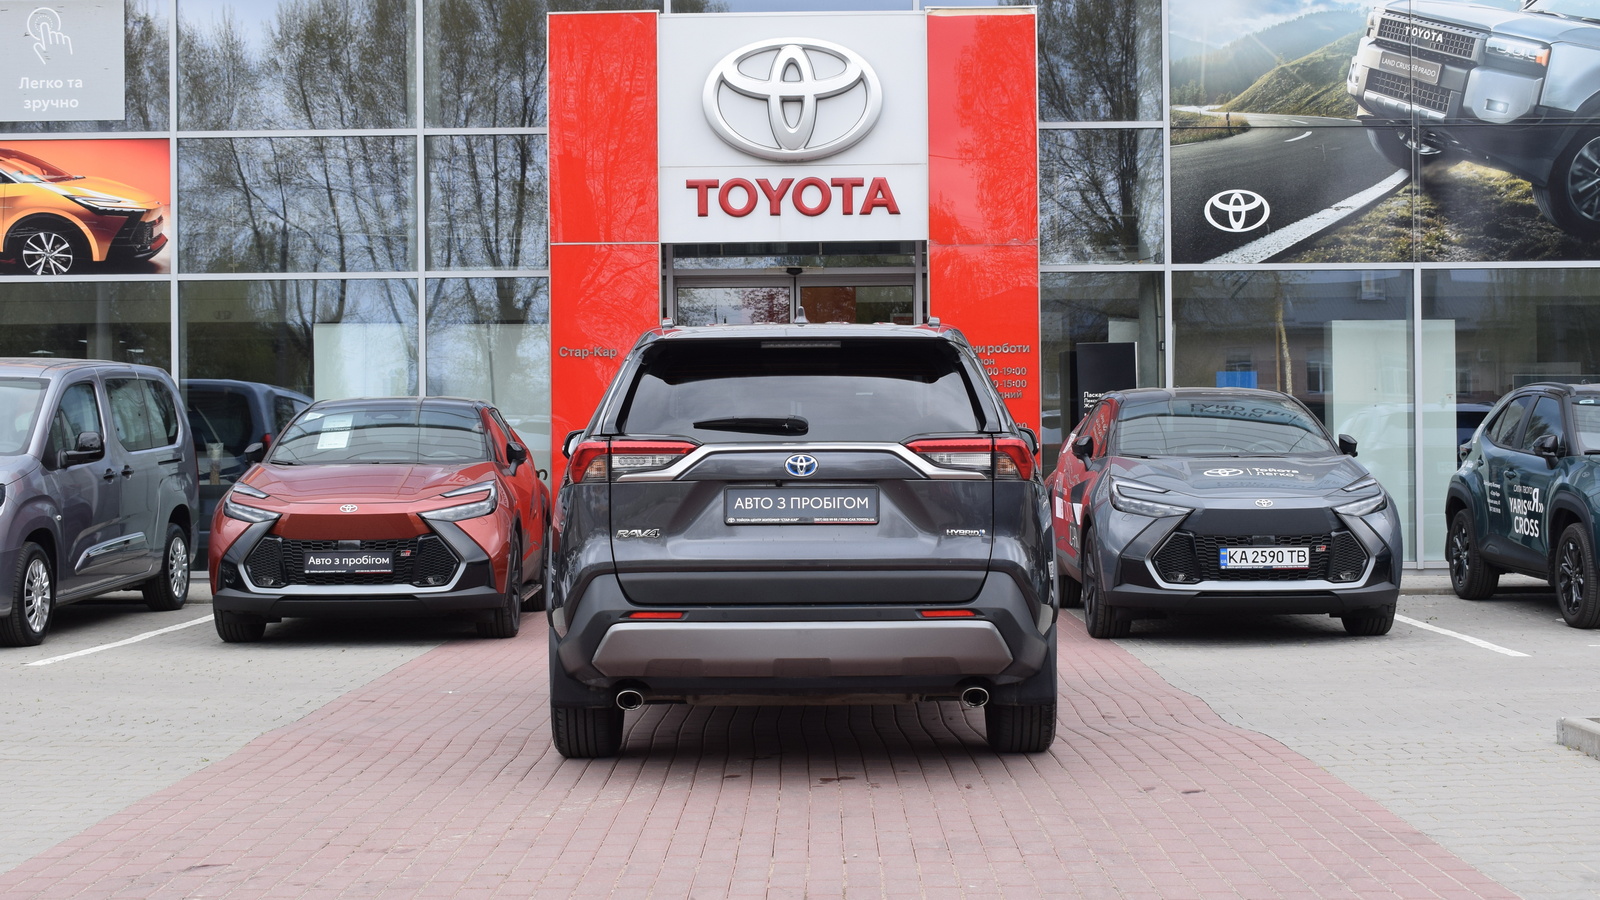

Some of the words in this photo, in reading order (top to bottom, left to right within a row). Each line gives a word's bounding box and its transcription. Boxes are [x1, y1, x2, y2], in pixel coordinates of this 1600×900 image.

[1405, 26, 1443, 43] TOYOTA
[1381, 57, 1396, 67] LAND
[1418, 67, 1436, 77] PRADO
[18, 77, 63, 89] Легко
[67, 79, 83, 88] та
[23, 98, 79, 111] зручно
[686, 177, 901, 218] TOYOTA
[559, 346, 618, 359] Стар-Кар
[987, 343, 1030, 356] роботи
[734, 497, 773, 509] АВТО
[790, 496, 869, 509] ПРОБІГОМ
[1509, 497, 1527, 515] YARIS
[616, 529, 660, 538] RAV4
[1514, 516, 1539, 538] CROSS
[308, 556, 332, 565] Авто
[342, 555, 390, 566] пробігом
[1228, 550, 1248, 563] KA
[1252, 550, 1284, 563] 2590
[1287, 550, 1307, 563] TB
